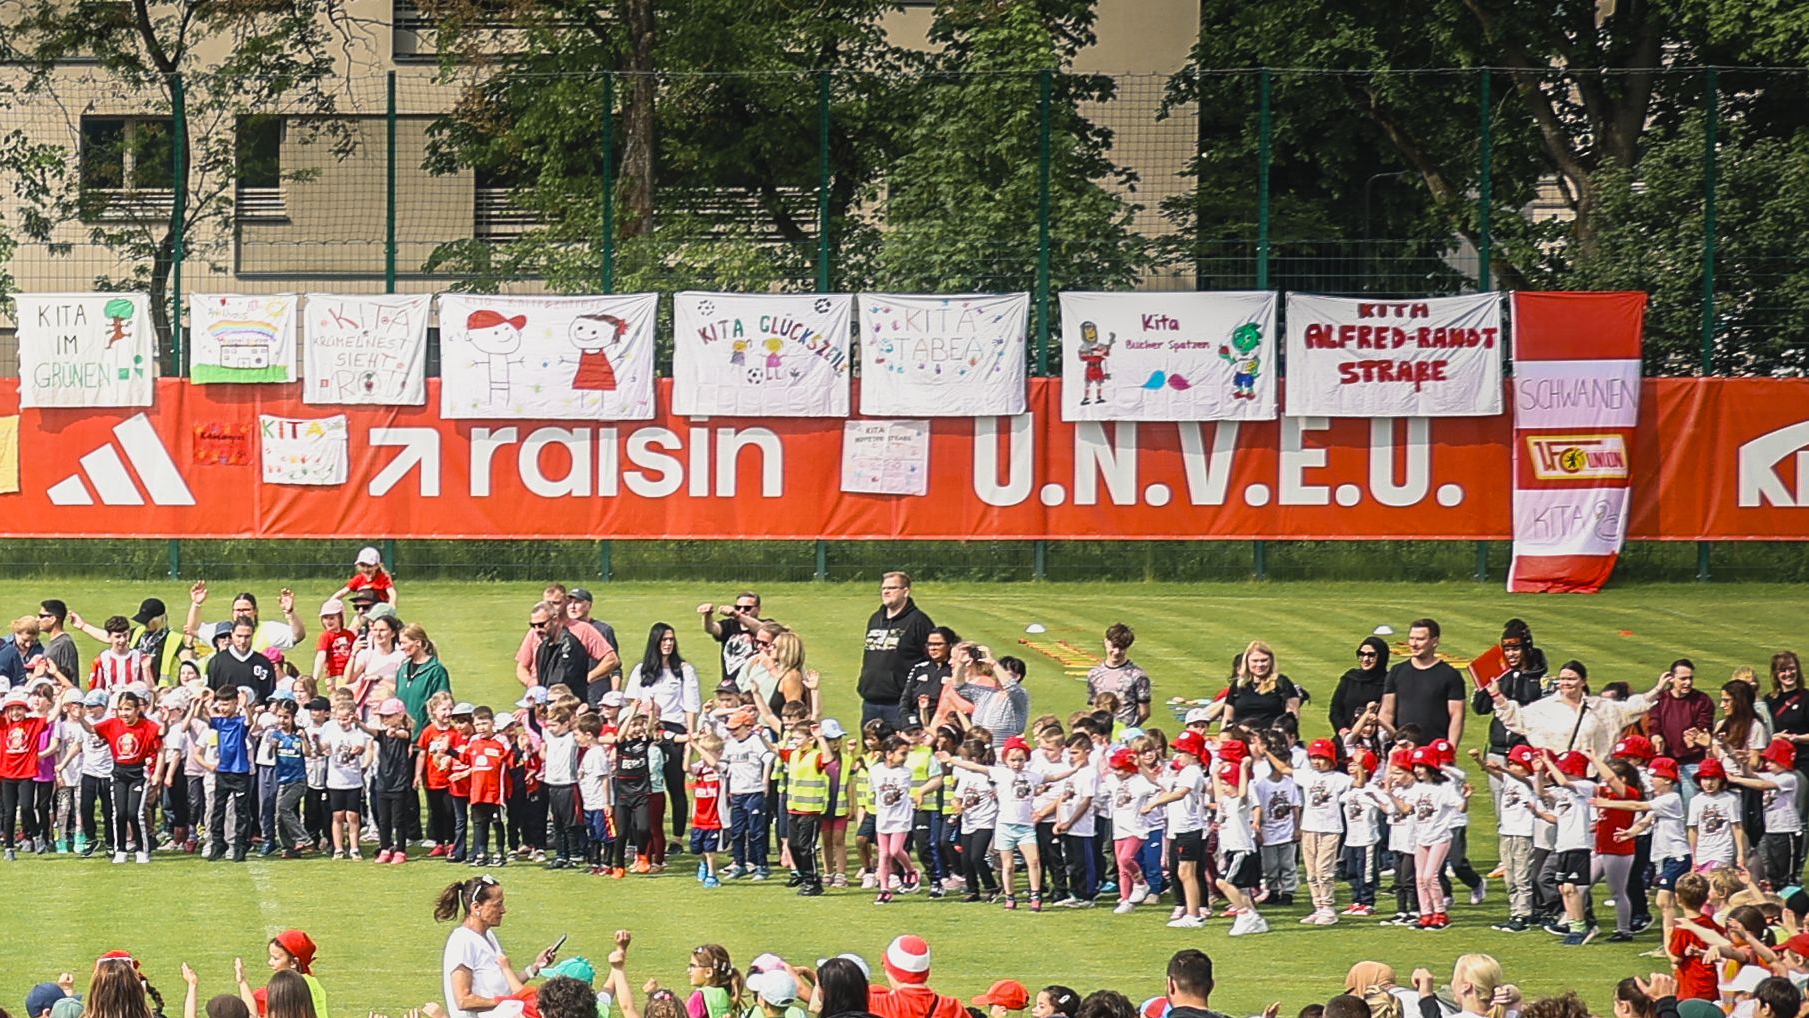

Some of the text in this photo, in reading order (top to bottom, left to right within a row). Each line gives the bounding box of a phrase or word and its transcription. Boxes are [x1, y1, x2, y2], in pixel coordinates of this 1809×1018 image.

[38, 304, 87, 328] KITA
[328, 301, 410, 337] KITA
[904, 308, 977, 333] KITA
[1141, 313, 1181, 332] Kita
[1357, 302, 1430, 319] KITA
[697, 318, 744, 345] KITA
[1303, 323, 1498, 350] ALFRED-RANDT
[56, 335, 78, 355] IM
[894, 336, 984, 362] TABEA
[1125, 339, 1211, 353] Bucher Spatzen
[334, 352, 398, 369] SIEHT
[33, 361, 111, 388] GRÜNEN
[333, 370, 409, 400] ROT
[1518, 378, 1638, 411] SCHWANEN
[262, 419, 325, 440] KITA
[469, 416, 785, 499] raisin
[974, 410, 1466, 508] U.N.V.E.U.
[1585, 451, 1625, 469] UNION
[1533, 504, 1584, 538] KITA
